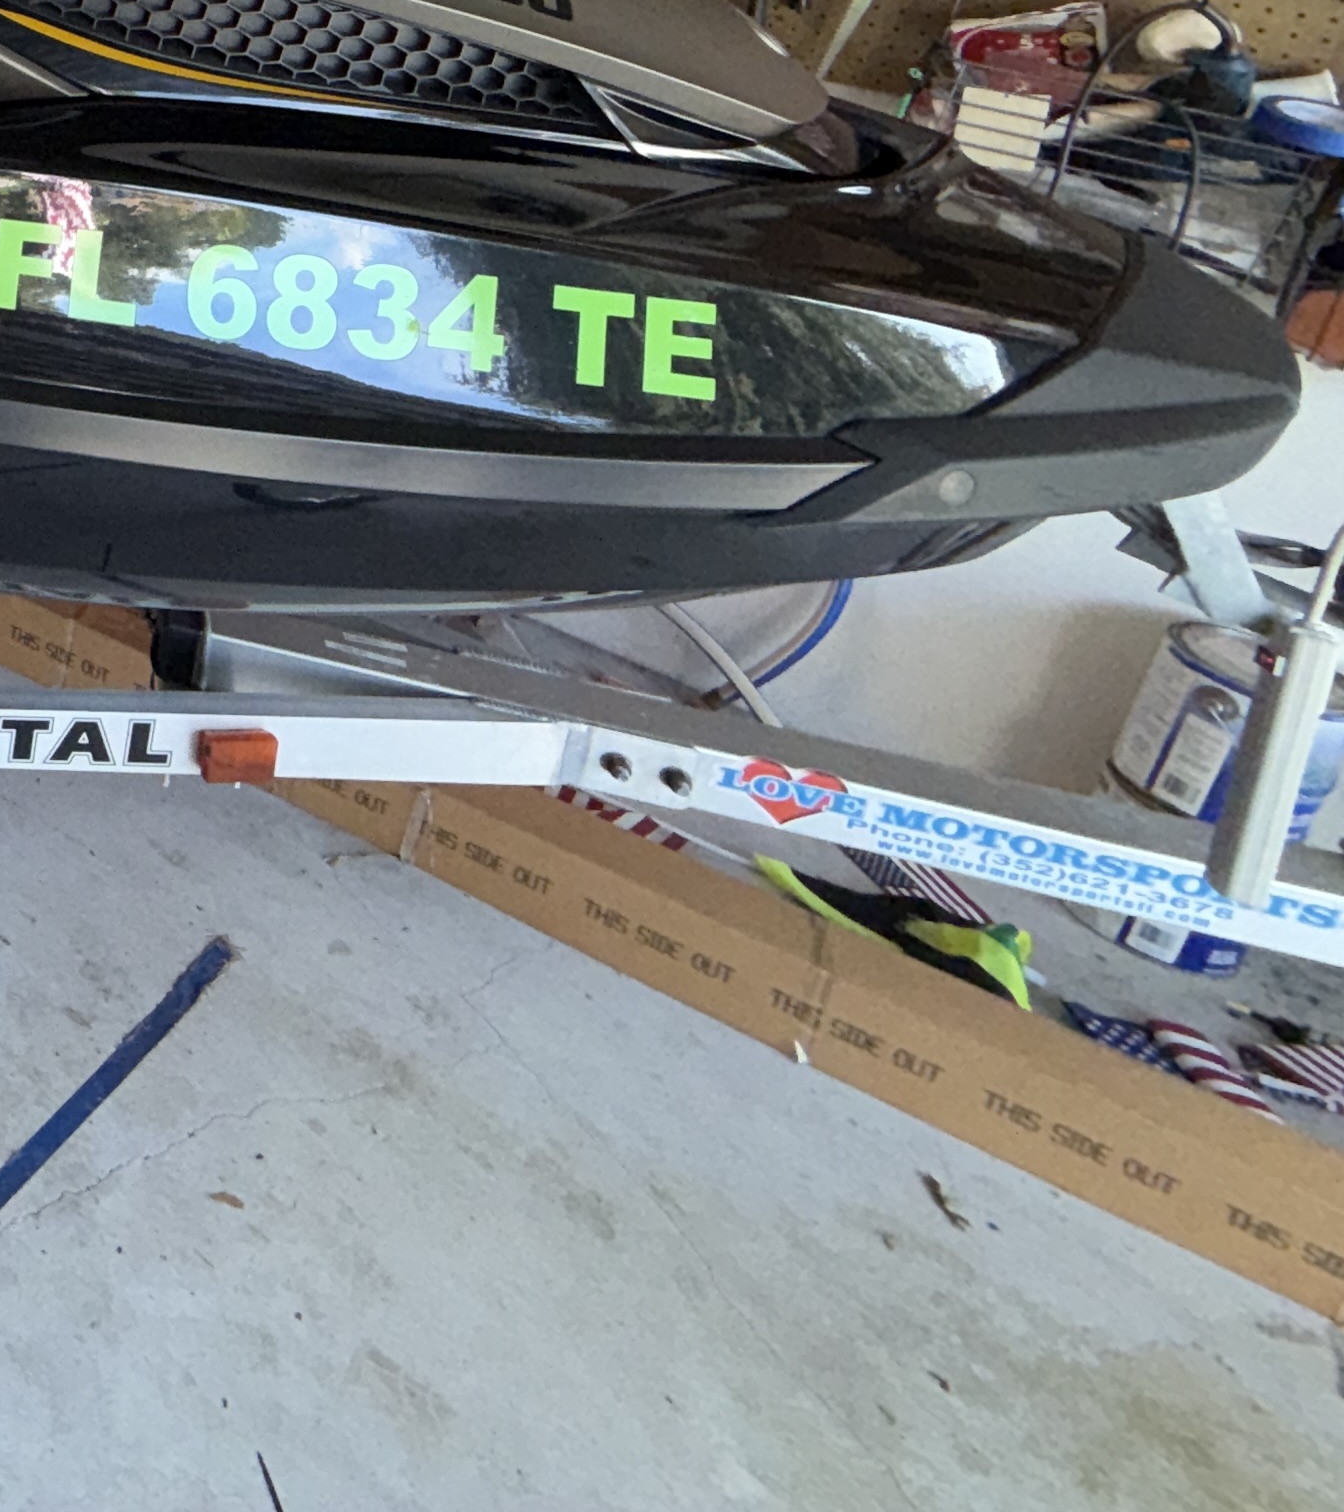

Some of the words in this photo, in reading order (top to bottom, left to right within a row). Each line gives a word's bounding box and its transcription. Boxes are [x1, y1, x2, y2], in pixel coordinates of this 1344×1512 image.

[187, 245, 505, 372] 6834
[553, 285, 717, 401] TE
[10, 625, 40, 651] THIS
[46, 642, 76, 669] SIDE
[81, 661, 110, 682] OUT
[354, 789, 389, 814] OUT
[465, 841, 505, 875] SIDE
[513, 864, 551, 895] OUT
[717, 766, 866, 819] LOVE
[878, 802, 1341, 929] MOTORSPOTS
[847, 819, 966, 857] Phone:
[979, 850, 1234, 920] (352)621-3678
[583, 897, 630, 935] THIS
[634, 924, 684, 960] SIDE
[690, 951, 736, 983] OUT
[769, 988, 823, 1031] THIS
[829, 1018, 886, 1059] SIDE
[892, 1047, 945, 1082] OUT
[984, 1089, 1042, 1133] THIS
[1050, 1122, 1112, 1167] SIDE
[1122, 1158, 1182, 1195] OUT
[1227, 1203, 1293, 1251] THIS
